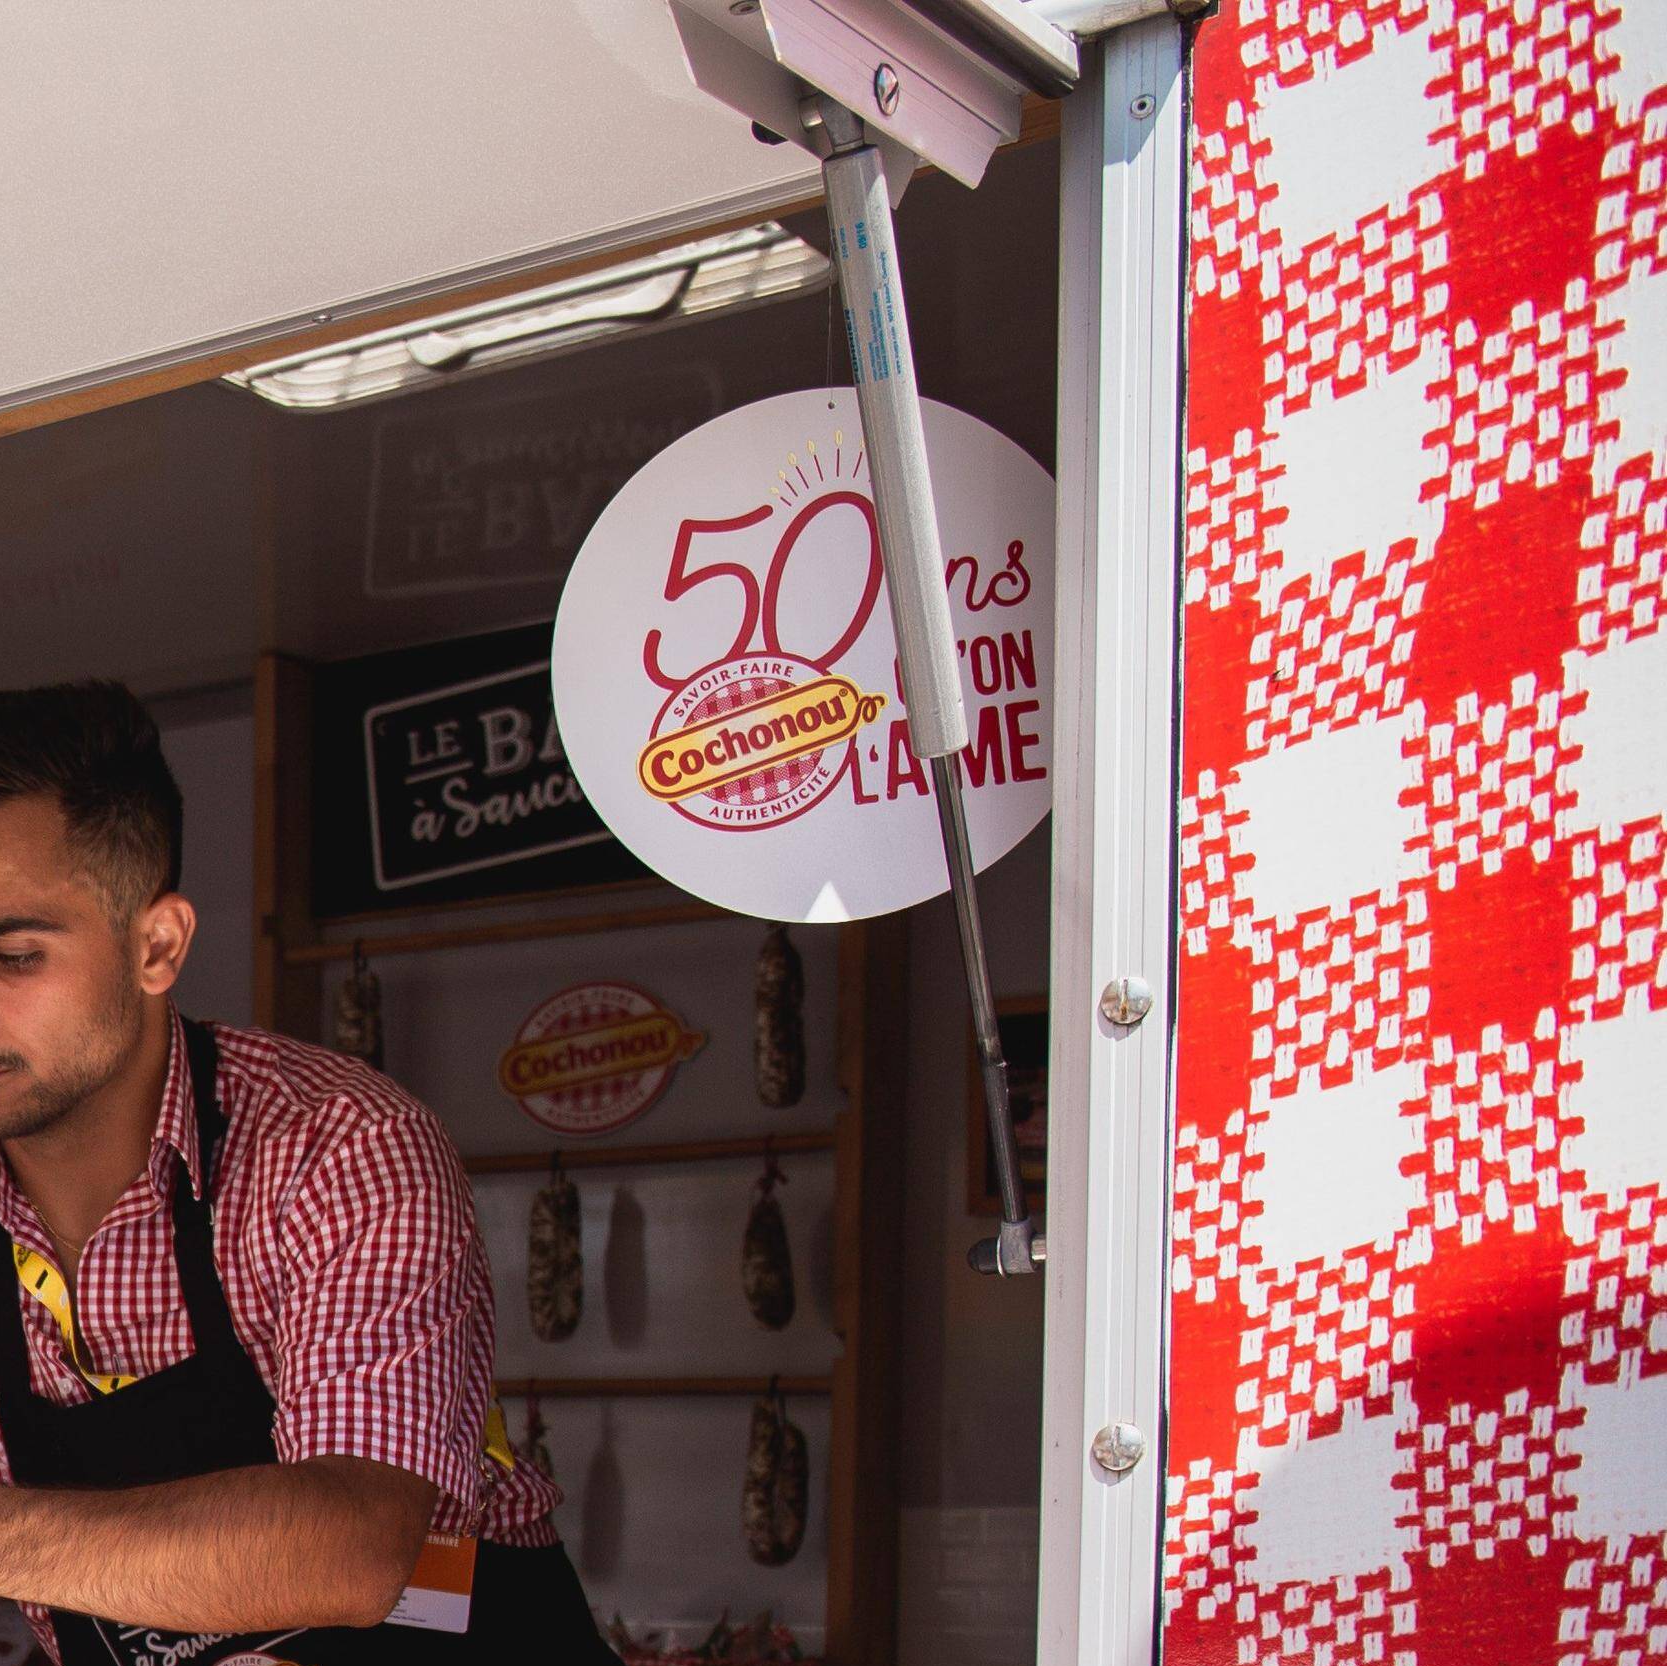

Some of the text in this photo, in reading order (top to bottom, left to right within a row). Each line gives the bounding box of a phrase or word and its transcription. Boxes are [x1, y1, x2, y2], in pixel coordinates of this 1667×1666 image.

[643, 491, 884, 690] 50
[946, 540, 1031, 611] ns
[673, 662, 795, 718] SAVOIR-FAIRE
[894, 630, 1037, 705] 'ON
[408, 720, 462, 766] LE
[650, 690, 849, 787] Cochonou
[851, 699, 1047, 805] L'AME
[411, 798, 446, 841] à
[709, 765, 830, 822] AUTHENTICITÉ
[511, 1030, 668, 1085] Cochonou
